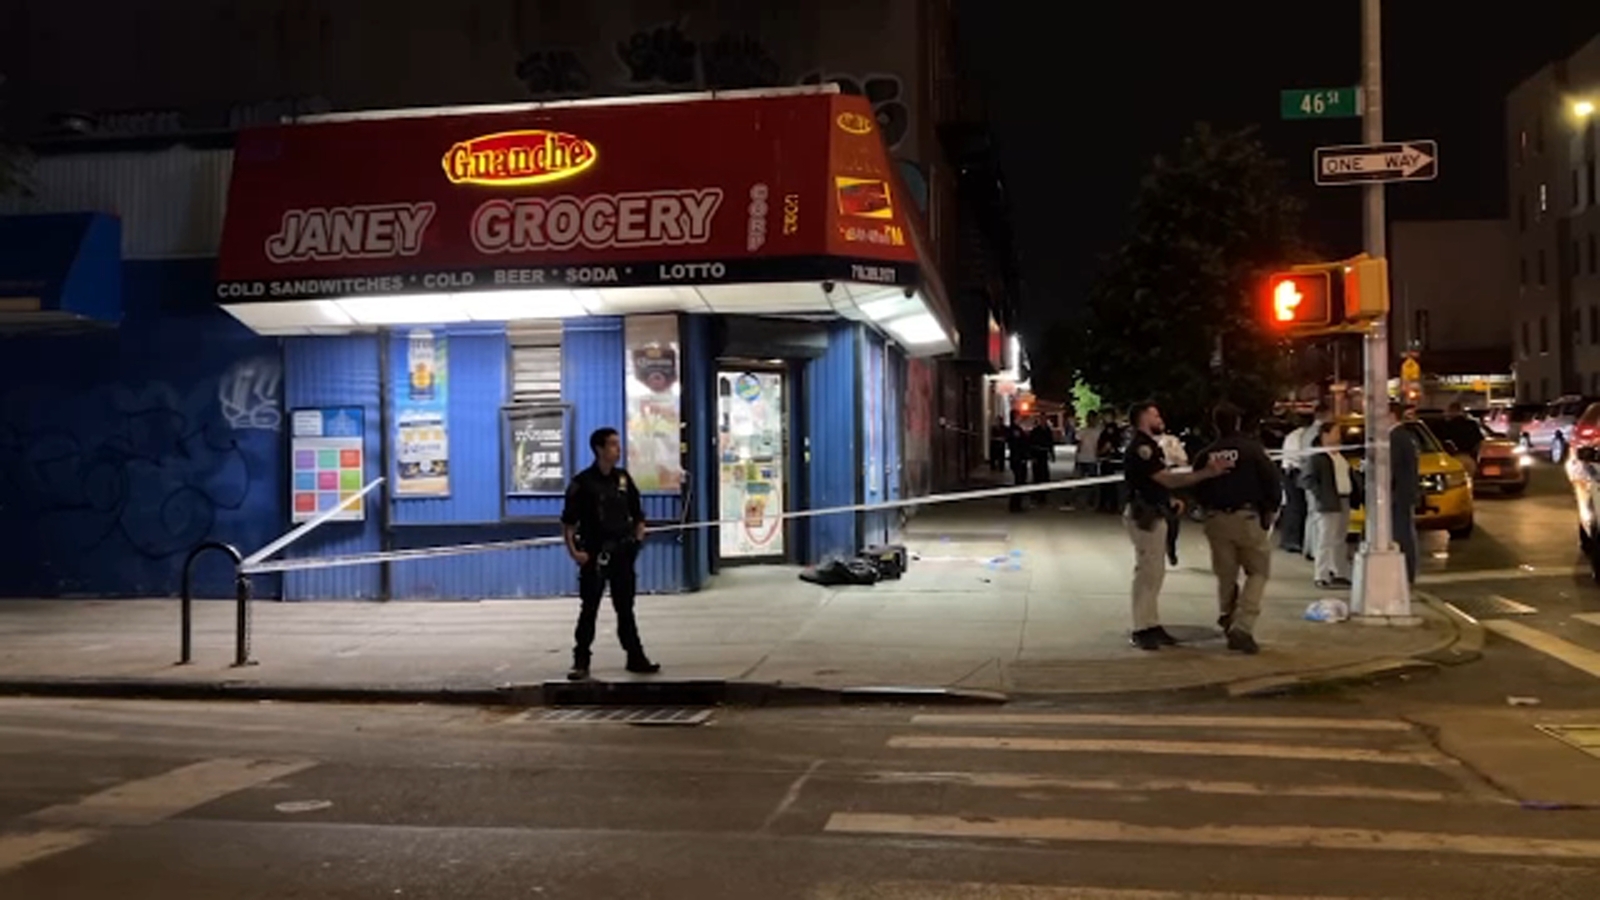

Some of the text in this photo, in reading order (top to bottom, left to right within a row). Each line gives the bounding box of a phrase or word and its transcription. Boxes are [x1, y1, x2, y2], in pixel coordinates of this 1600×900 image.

[1299, 93, 1324, 114] 46
[448, 133, 587, 181] Guanche
[1325, 154, 1420, 174] ONE WAY
[265, 203, 435, 261] JANEY
[471, 189, 723, 252] GROCERY
[217, 261, 726, 297] COLD SANDWITCHES COLD BEER SODA LOTTO
